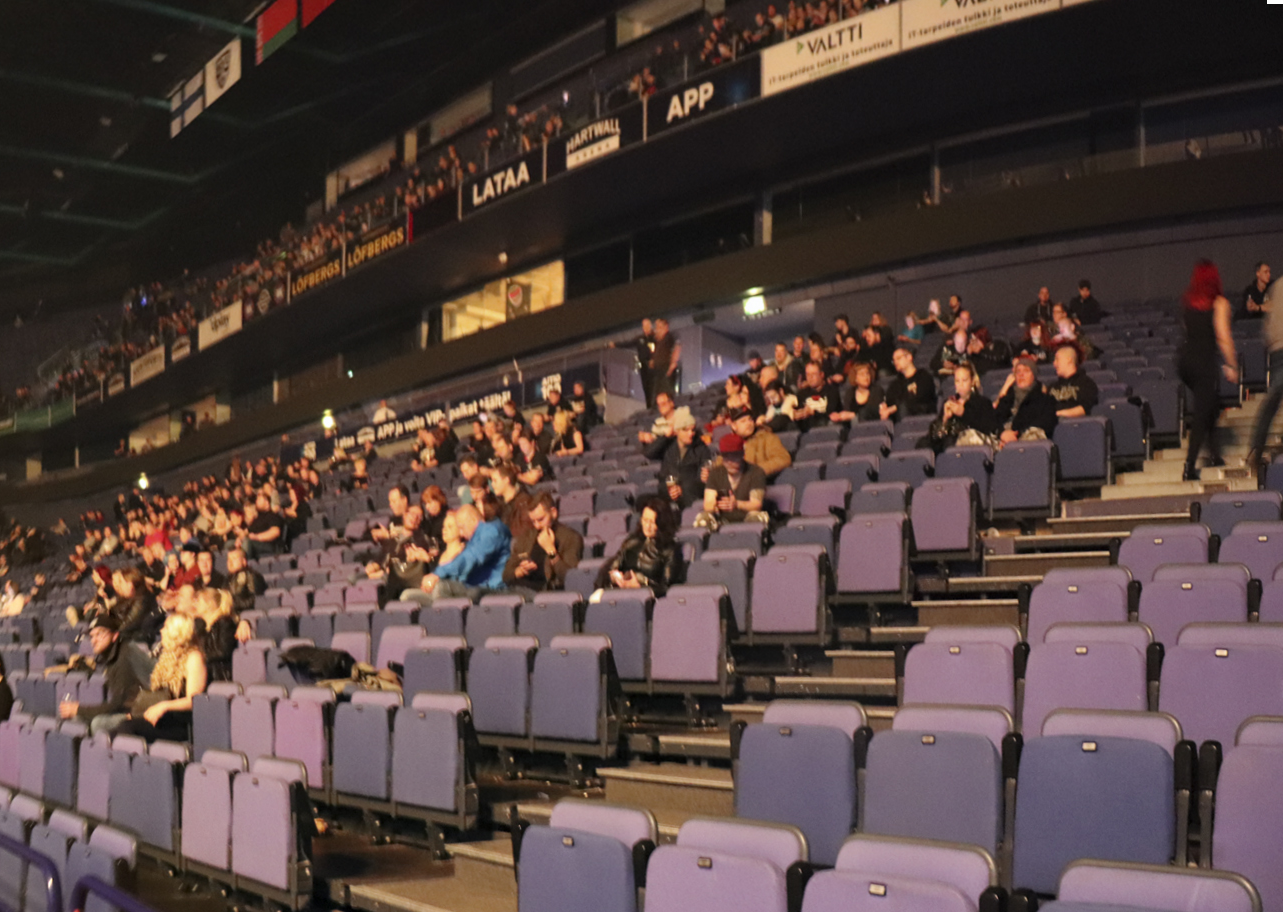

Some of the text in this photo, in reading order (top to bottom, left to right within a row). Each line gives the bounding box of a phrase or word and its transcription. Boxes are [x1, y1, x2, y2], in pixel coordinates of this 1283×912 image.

[964, 7, 991, 22] tulkki
[993, 5, 1002, 16] ja
[807, 22, 863, 55] VALTTI
[817, 55, 840, 68] tulkki
[842, 53, 849, 61] ja
[852, 39, 893, 57] toteuttaja
[666, 82, 714, 123] APP
[566, 118, 620, 155] HARTWALL
[472, 161, 530, 206] LATAA
[347, 226, 404, 268] LÖFBERGS
[292, 259, 340, 296] LÖFBERGS
[377, 422, 395, 440] APP
